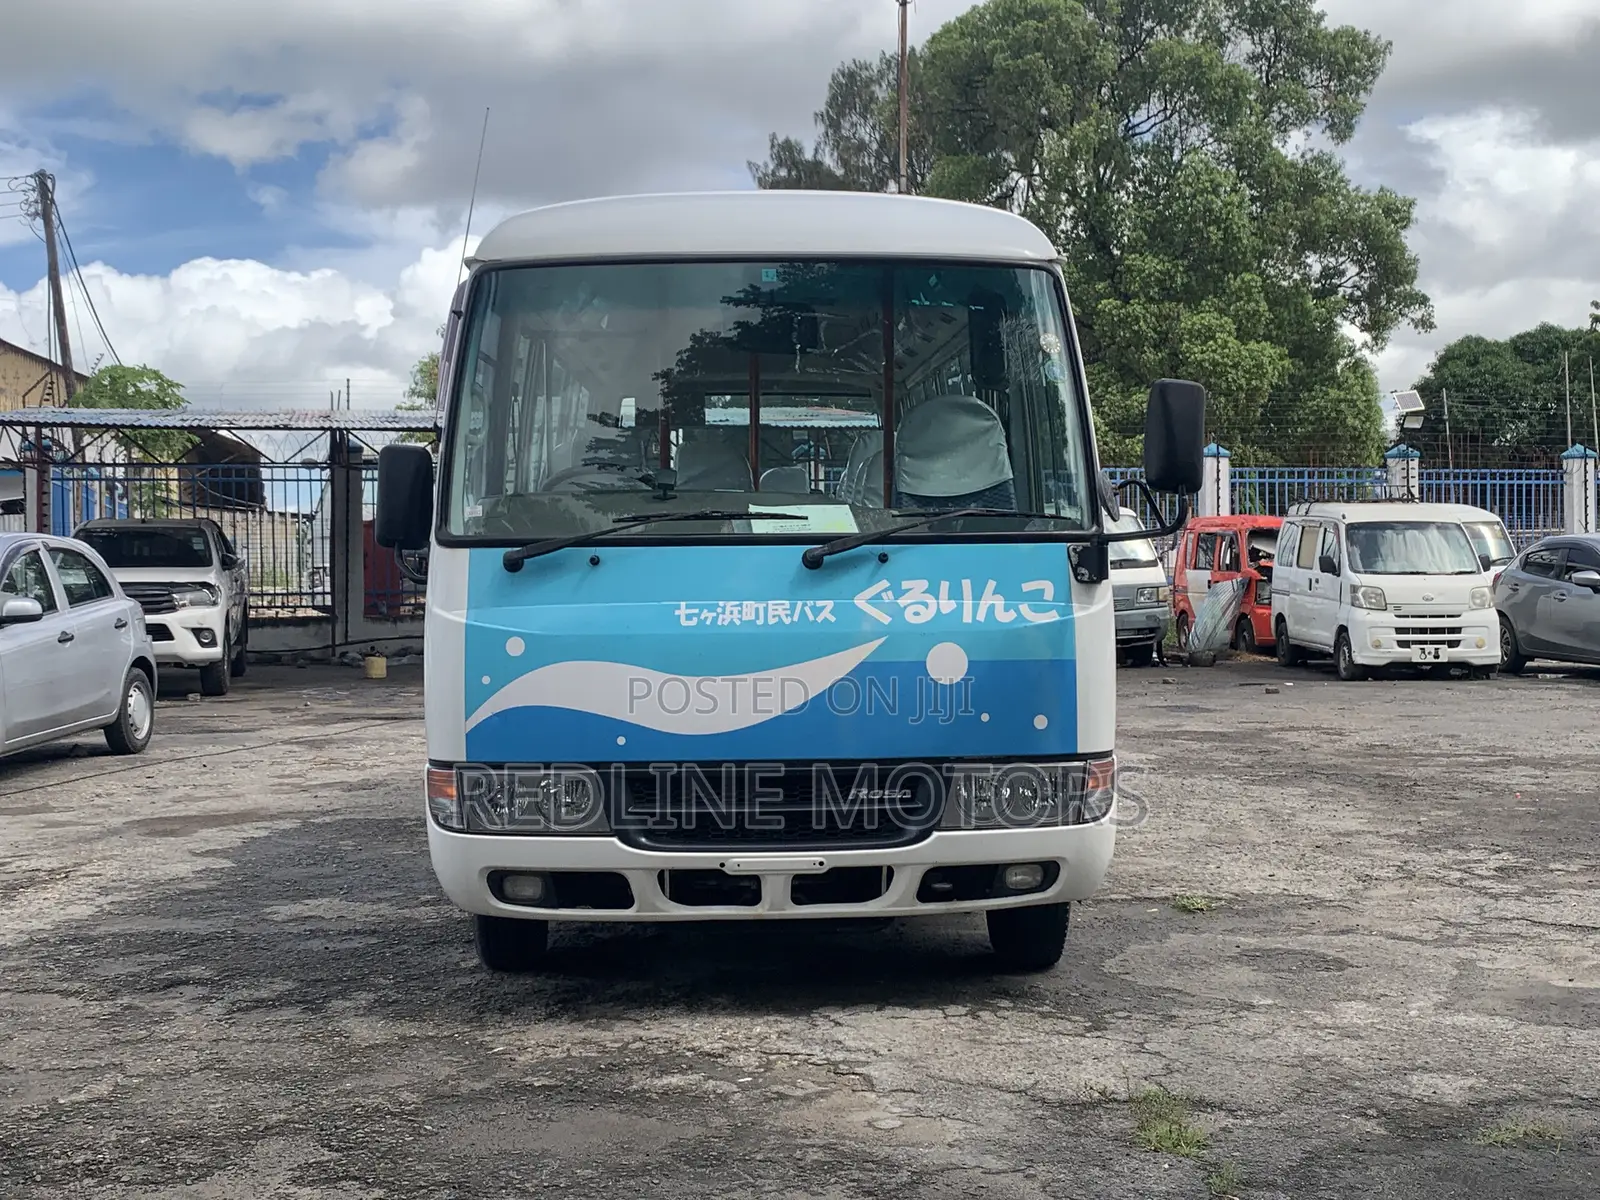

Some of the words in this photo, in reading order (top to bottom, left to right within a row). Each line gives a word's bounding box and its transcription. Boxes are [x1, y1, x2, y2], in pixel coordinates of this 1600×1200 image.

[853, 579, 1059, 625] ぐるりんこ
